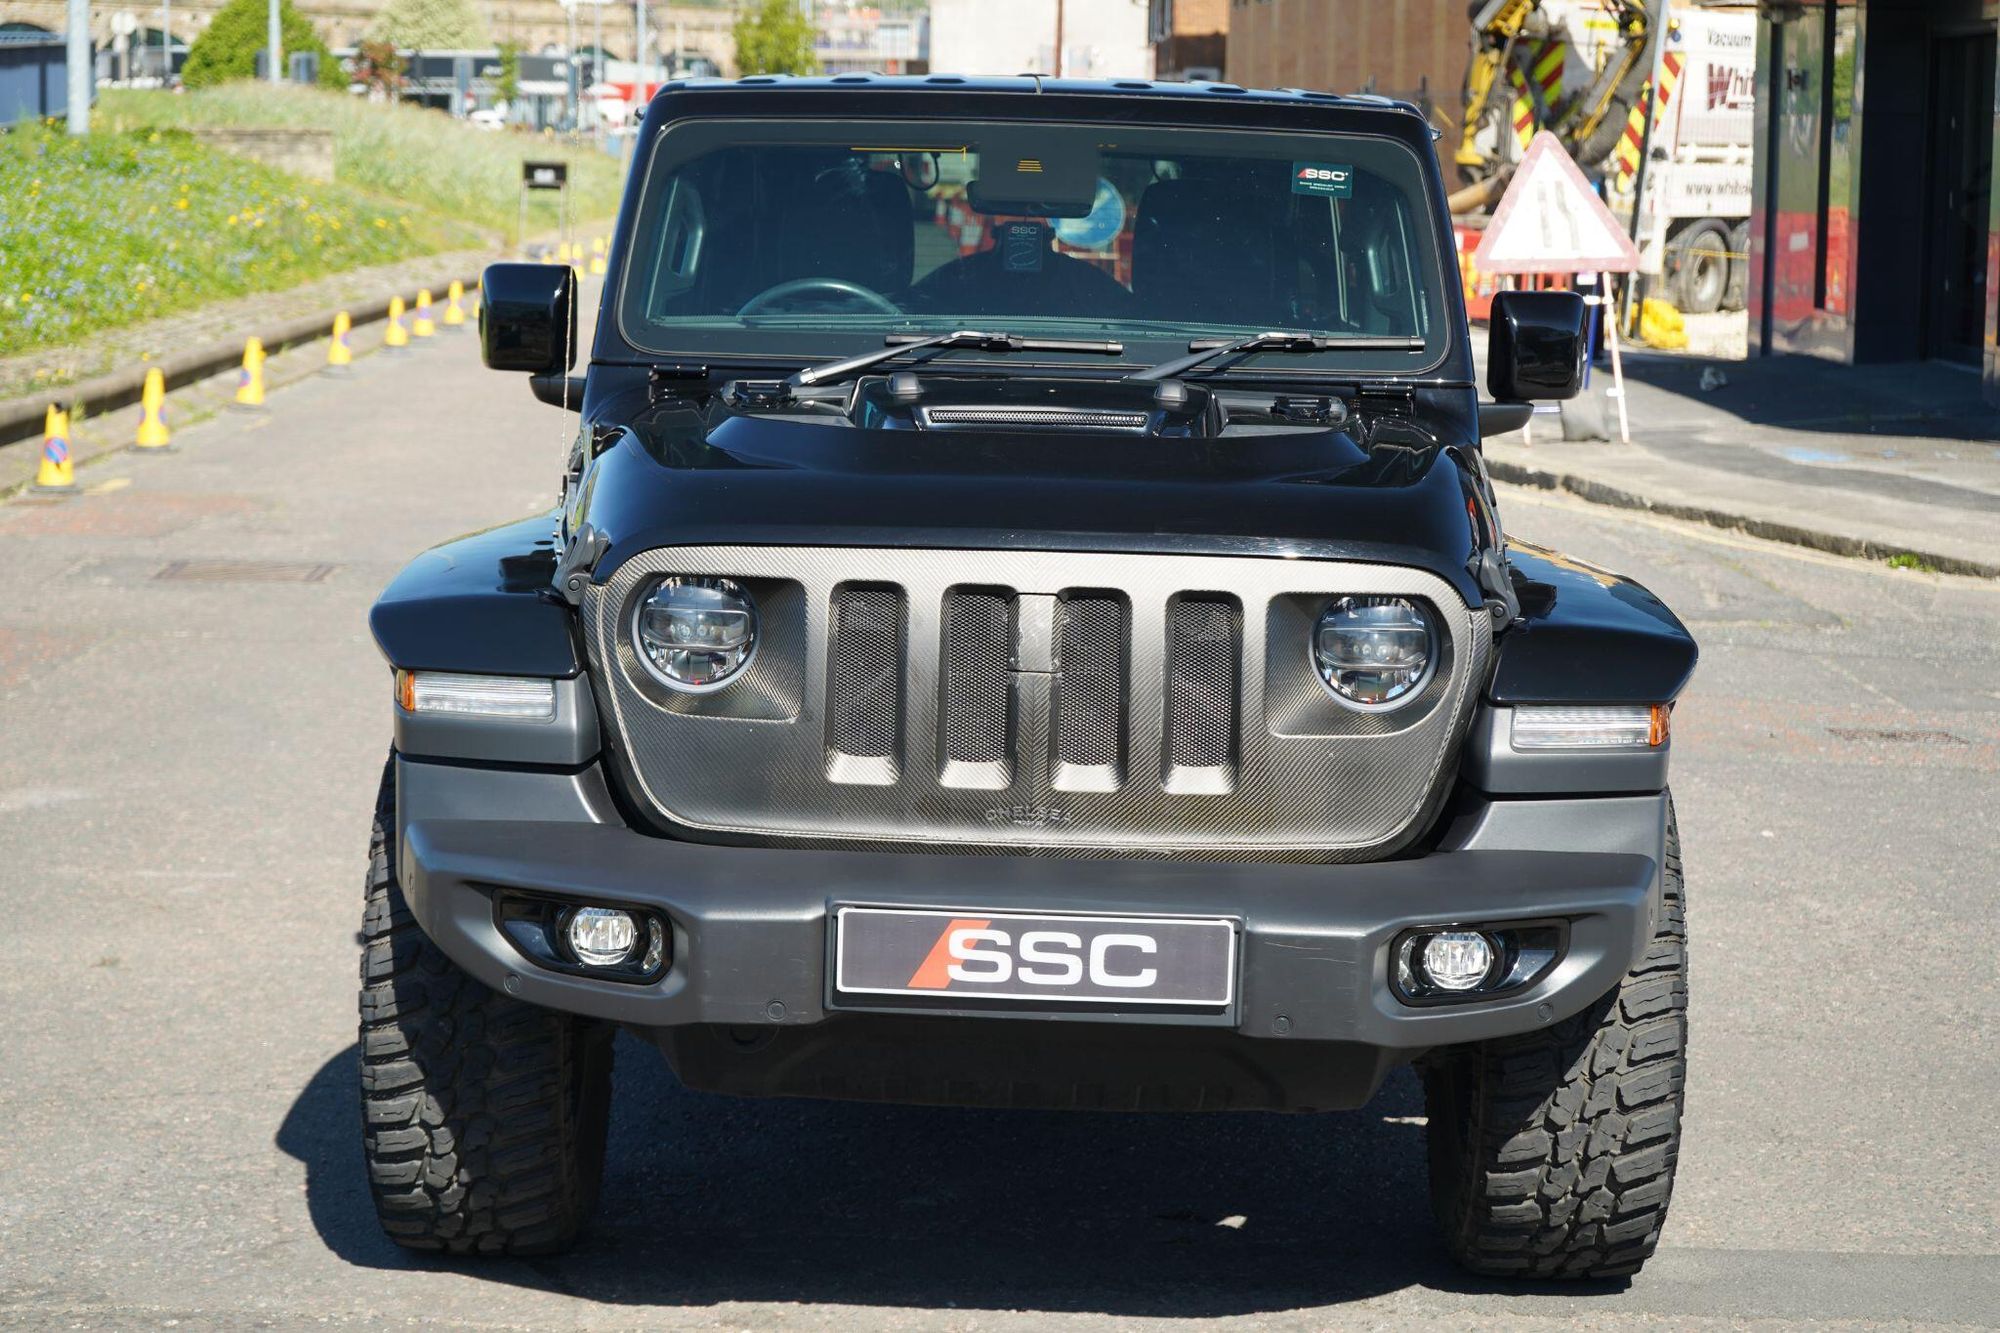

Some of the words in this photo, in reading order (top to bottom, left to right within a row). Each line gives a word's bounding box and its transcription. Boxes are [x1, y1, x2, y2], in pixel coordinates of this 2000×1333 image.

[1707, 26, 1752, 47] Vacuum
[1305, 168, 1345, 181] SSC
[947, 929, 1158, 987] SSC
